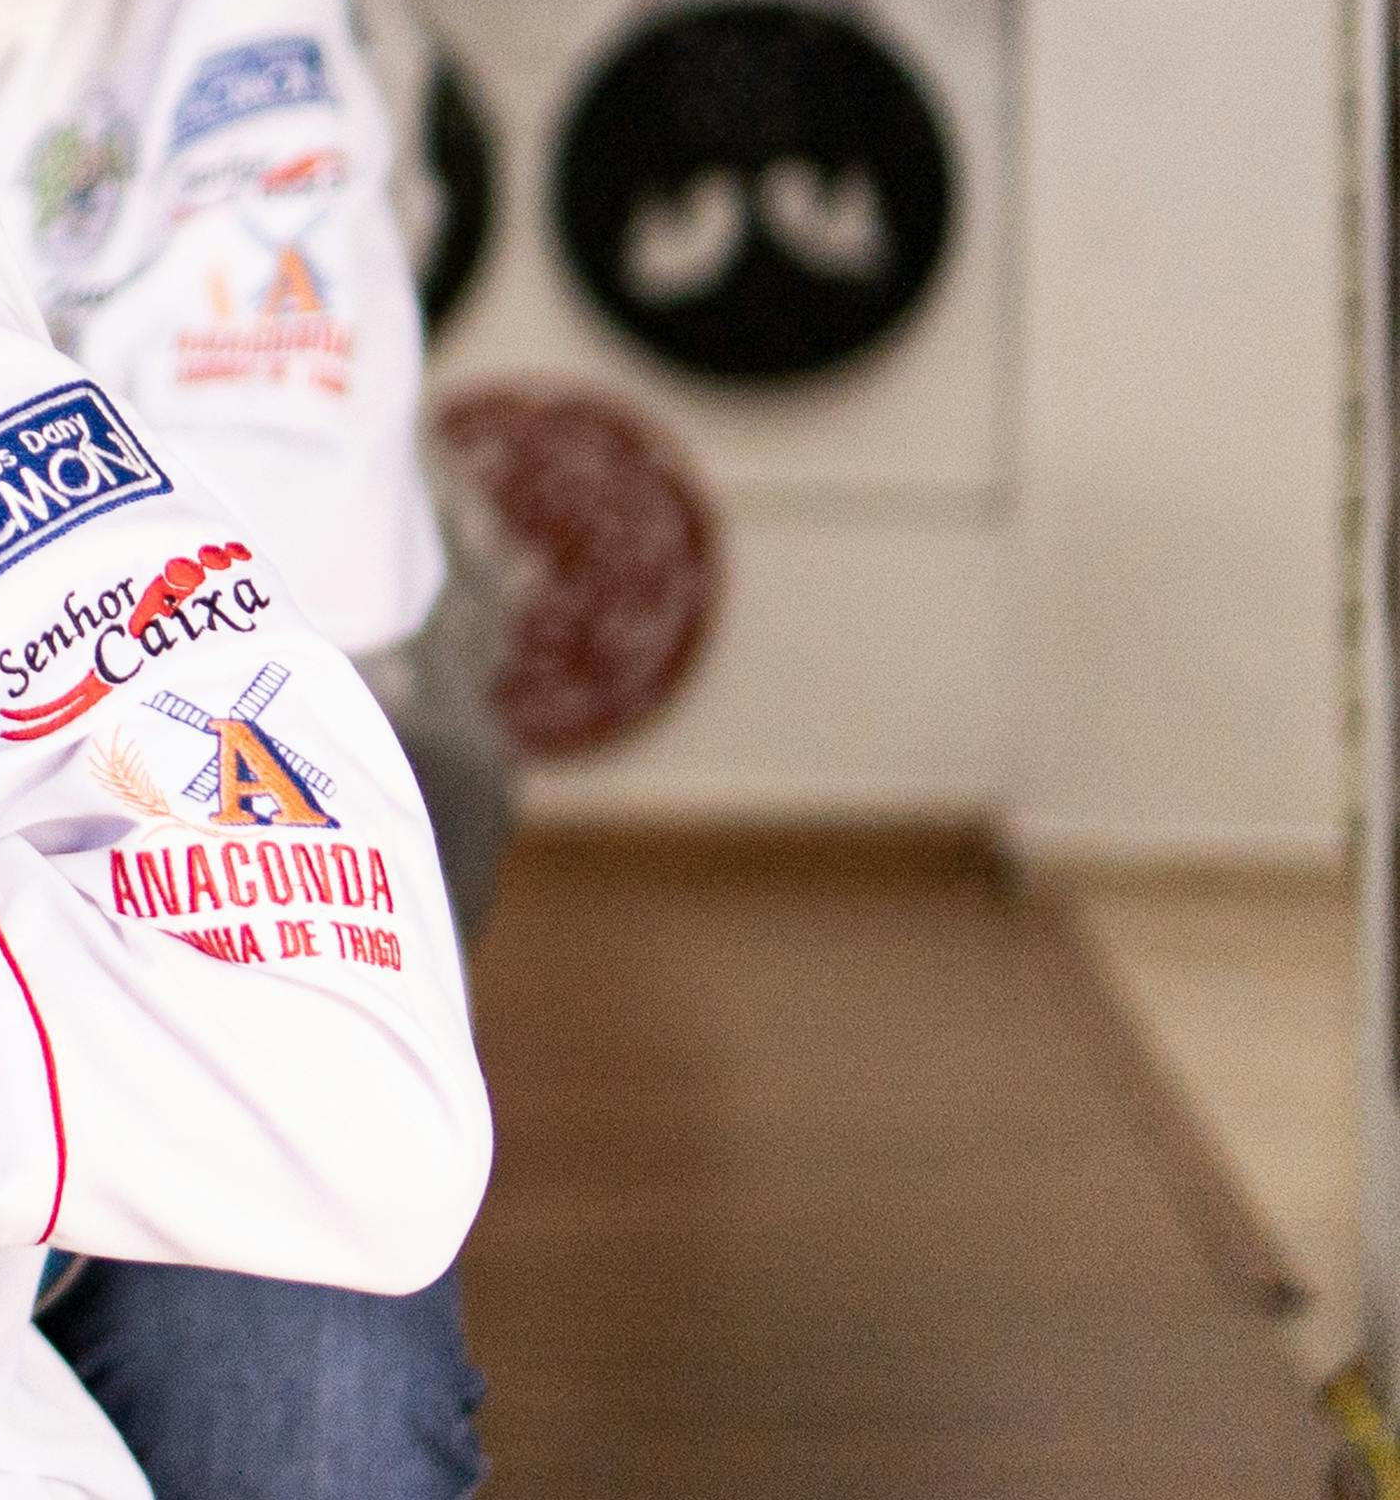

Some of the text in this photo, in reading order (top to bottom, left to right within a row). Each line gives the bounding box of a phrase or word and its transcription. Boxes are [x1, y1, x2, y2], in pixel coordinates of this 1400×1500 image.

[19, 412, 91, 455] Dany
[94, 578, 271, 685] Caixa
[109, 840, 394, 918] ANACONDA
[274, 920, 323, 959] DE
[329, 920, 402, 972] TRIGO
